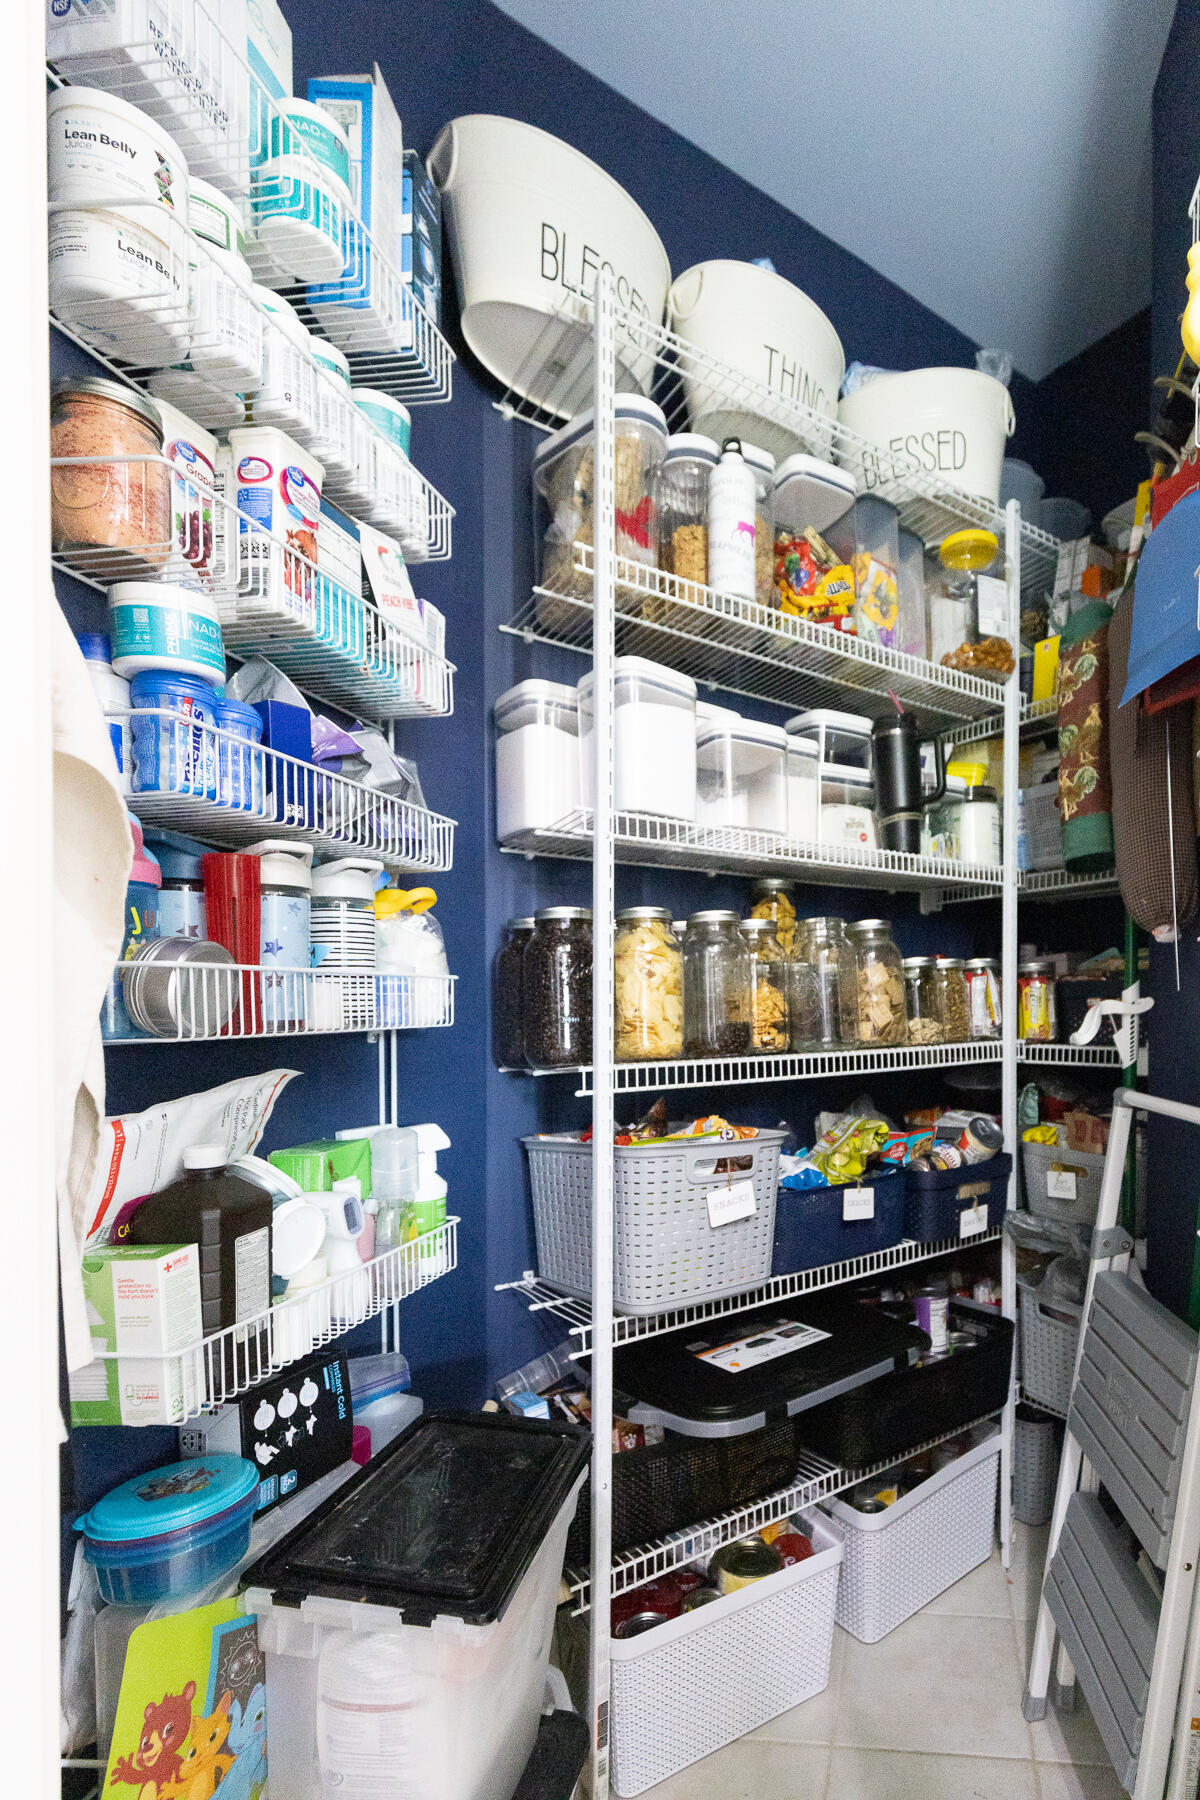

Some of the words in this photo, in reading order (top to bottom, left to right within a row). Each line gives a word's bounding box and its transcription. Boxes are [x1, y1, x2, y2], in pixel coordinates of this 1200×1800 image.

[53, 0, 69, 11] NSF
[64, 129, 97, 142] Lean
[99, 133, 137, 159] Belly
[64, 140, 93, 150] Juice
[117, 239, 154, 266] Lean
[155, 260, 181, 291] Bely
[166, 610, 178, 655] PRIME
[332, 1360, 344, 1396] Instant
[337, 1395, 347, 1420] Cold
